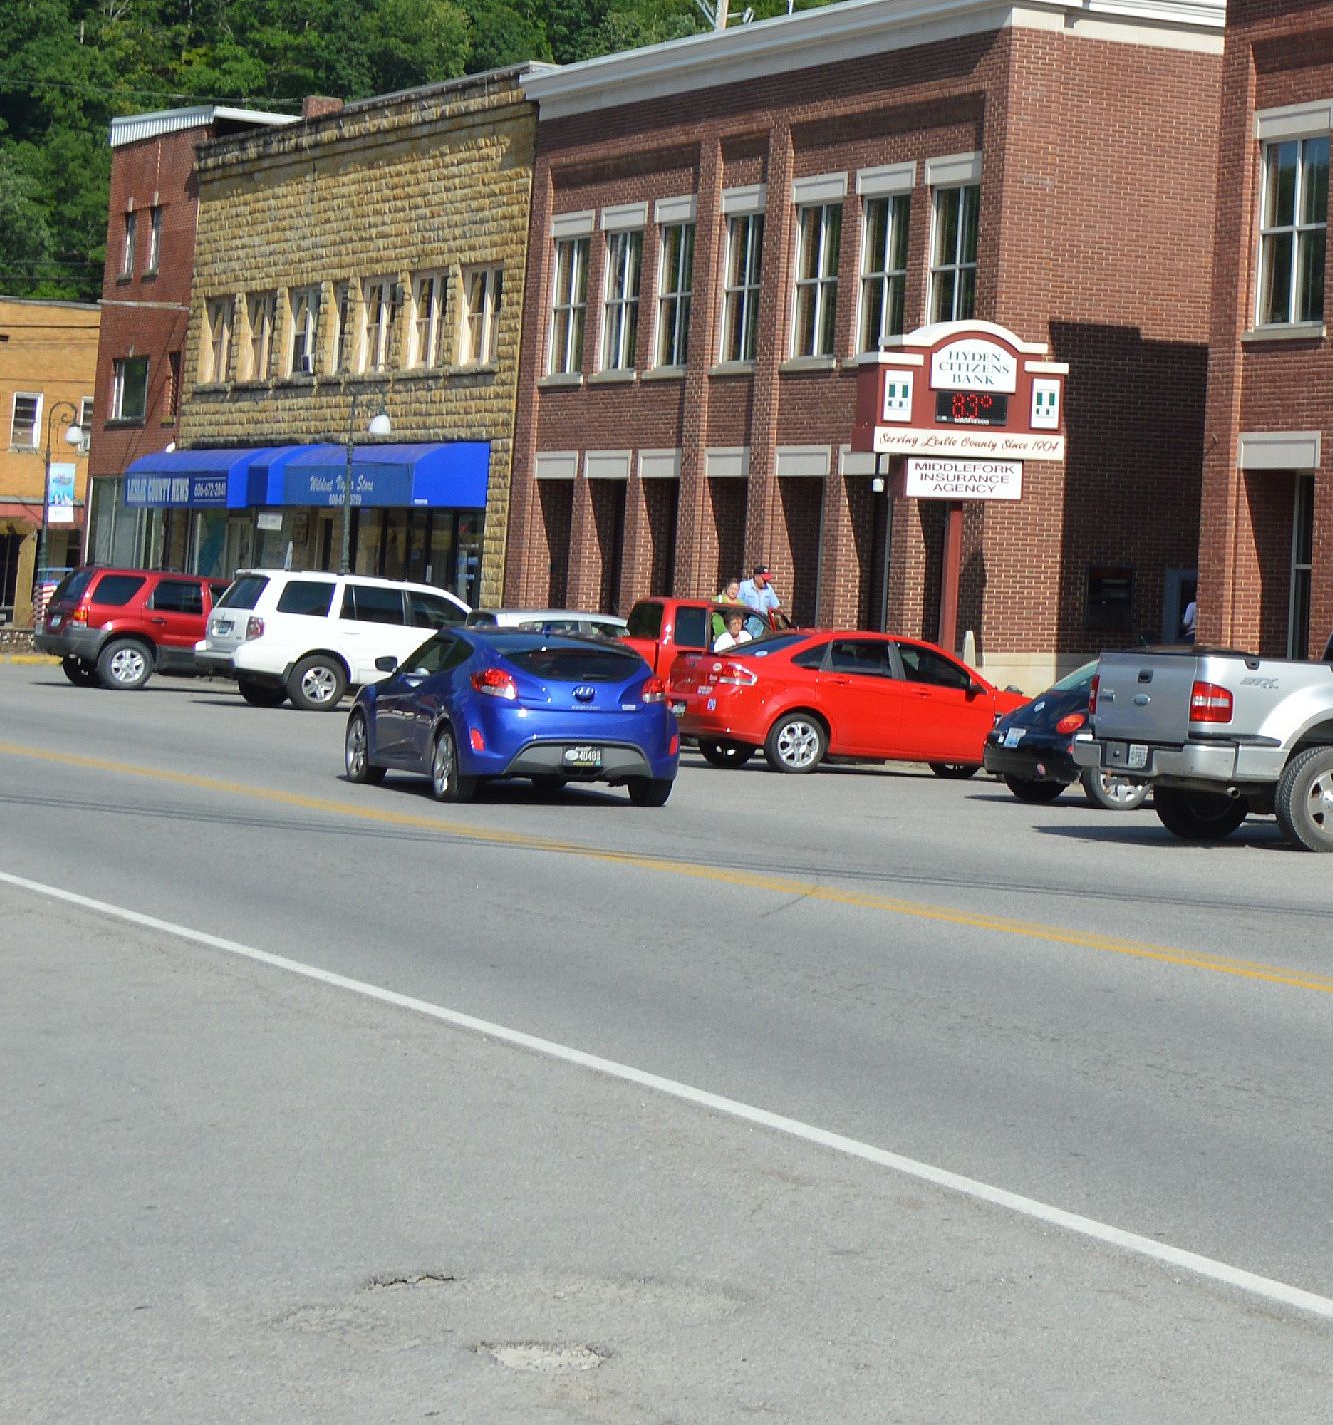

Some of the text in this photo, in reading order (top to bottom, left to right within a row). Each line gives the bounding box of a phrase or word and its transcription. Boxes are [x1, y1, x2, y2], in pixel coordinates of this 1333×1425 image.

[949, 350, 1002, 362] HYDEN
[939, 361, 1010, 374] CITIZENS
[952, 374, 995, 385] BANK
[880, 431, 919, 448] Serving
[921, 434, 958, 448] Leslie
[960, 437, 998, 452] County
[1001, 439, 1029, 451] Since
[914, 462, 1015, 475] MIDDLEFORK
[919, 473, 1010, 484] INSURANCE
[147, 478, 171, 503] COUNTY
[171, 478, 190, 503] NEWS
[932, 483, 997, 493] AGENCY
